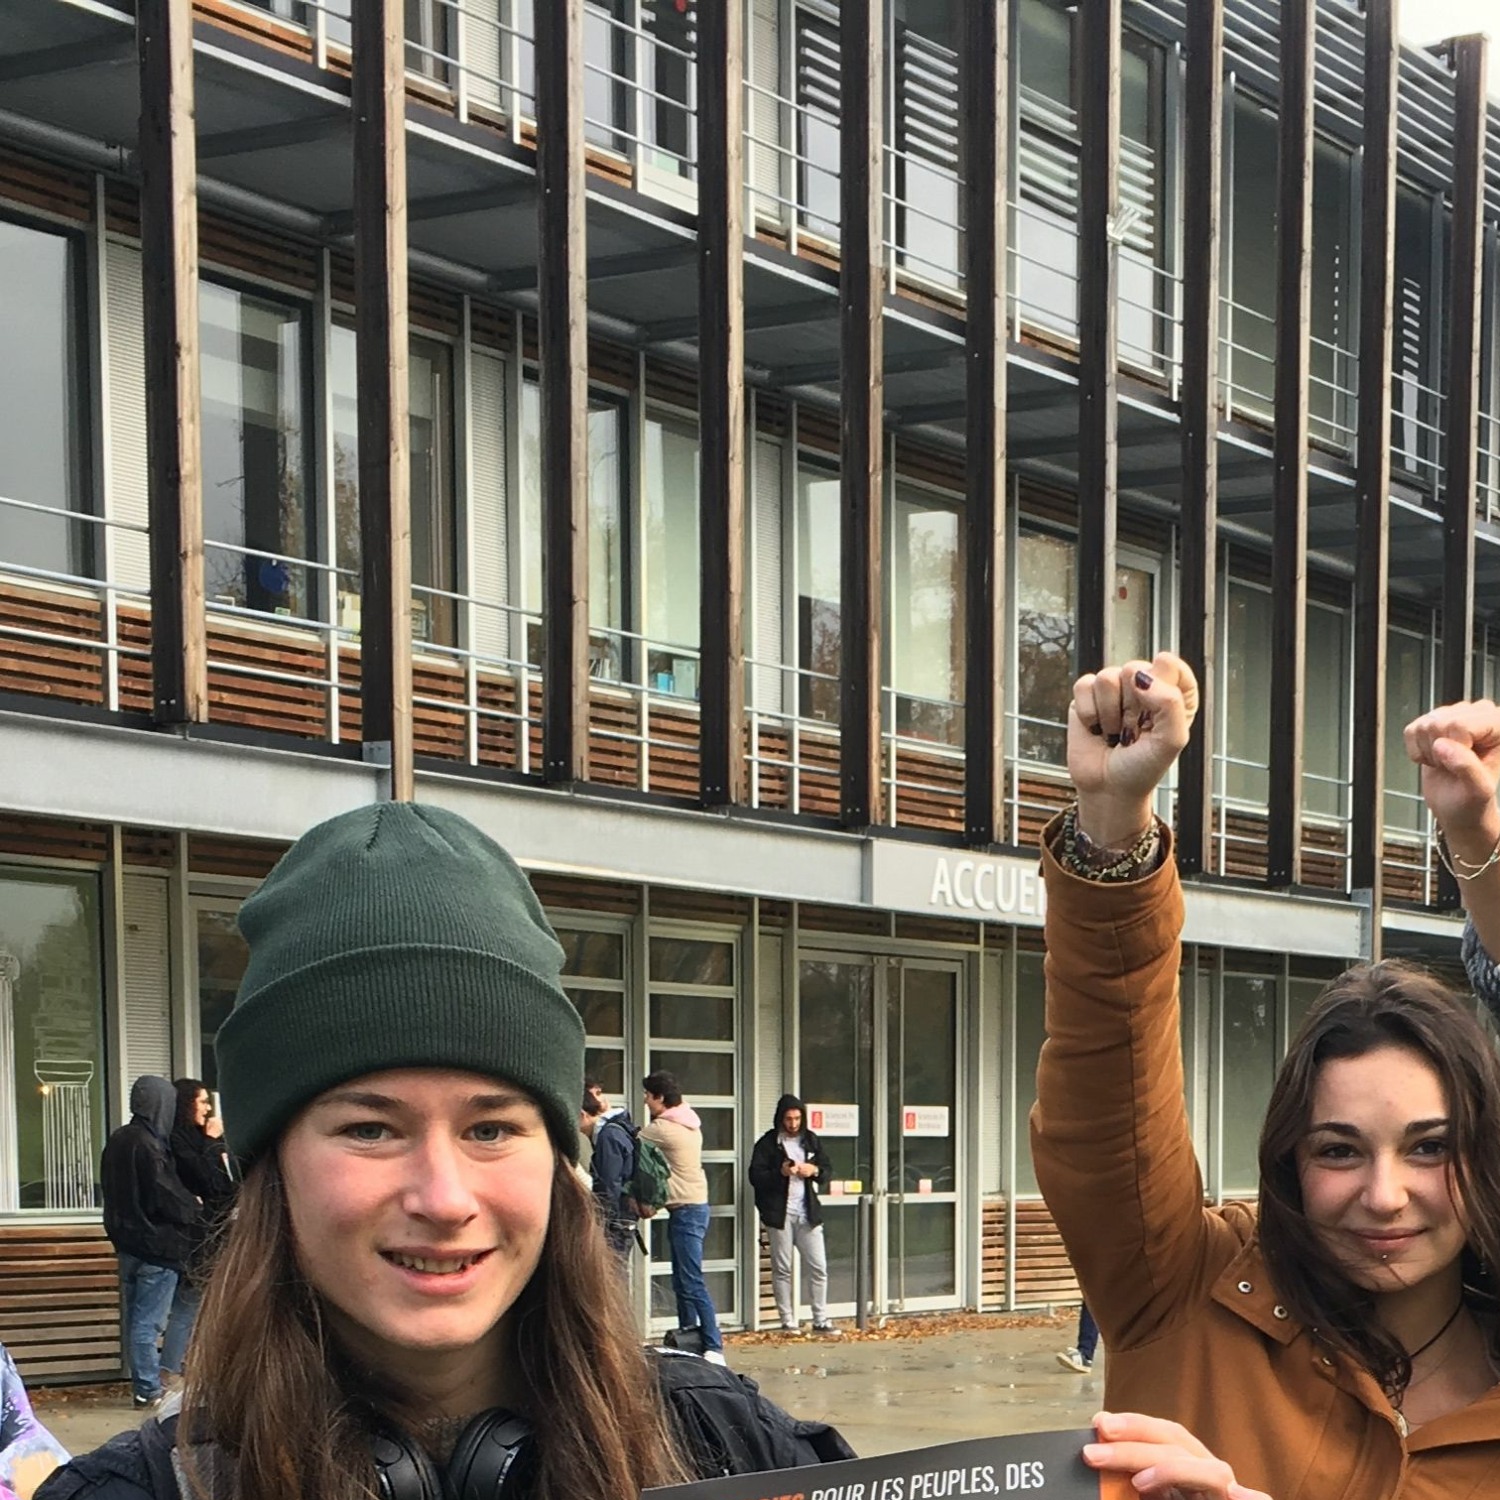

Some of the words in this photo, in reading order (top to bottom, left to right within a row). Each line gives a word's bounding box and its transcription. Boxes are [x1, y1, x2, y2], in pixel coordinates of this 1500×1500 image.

[930, 857, 1046, 915] ACCUEI
[909, 1465, 1000, 1500] PEUPLES,
[1006, 1461, 1045, 1491] DES
